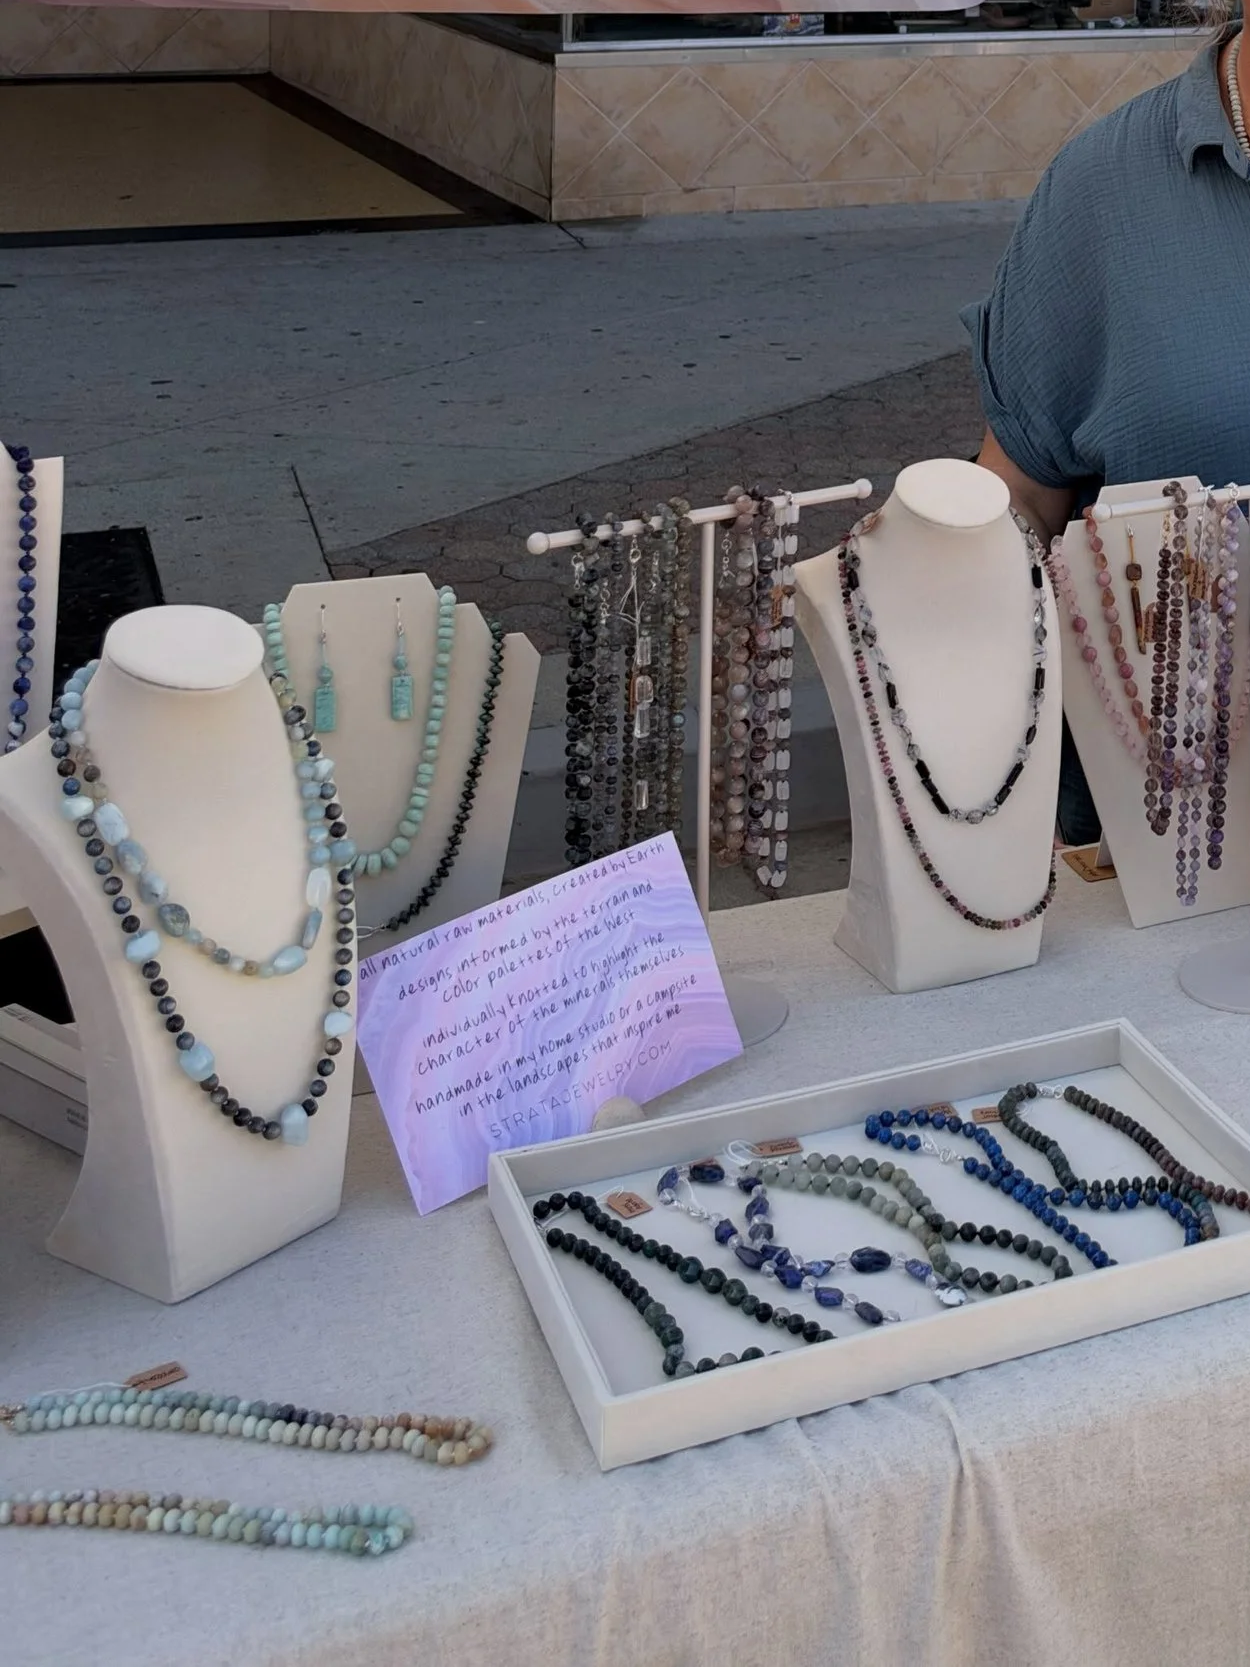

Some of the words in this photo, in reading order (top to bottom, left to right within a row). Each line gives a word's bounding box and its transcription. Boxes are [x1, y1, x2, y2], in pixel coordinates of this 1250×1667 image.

[360, 959, 377, 980] all
[381, 931, 440, 970] natural
[443, 922, 473, 942] raw
[477, 888, 550, 929] materials,
[552, 866, 607, 896] created
[610, 861, 626, 875] by
[626, 841, 665, 865] Earth
[398, 966, 452, 1001] designs
[457, 933, 528, 973] informed
[531, 928, 552, 941] by
[553, 911, 578, 930] the
[582, 890, 630, 918] terrain
[632, 878, 653, 897] and
[442, 975, 481, 1003] color
[487, 946, 552, 987] palettes
[555, 934, 573, 953] of
[578, 925, 601, 942] the
[603, 909, 636, 932] West
[415, 1070, 493, 1114] handmade
[498, 1060, 512, 1076] in
[515, 1051, 537, 1068] my
[538, 1032, 574, 1057] home
[578, 1011, 616, 1040] studio
[619, 1004, 632, 1020] or
[636, 999, 644, 1011] a
[646, 974, 697, 1004] campsite
[418, 1027, 501, 1076] character
[508, 1013, 526, 1034] of
[532, 1002, 559, 1022] the
[563, 976, 616, 1010] minerals
[618, 945, 685, 982] themselves
[422, 1001, 507, 1048] individually
[573, 965, 588, 979] to
[590, 941, 639, 976] highlight
[643, 932, 665, 948] the
[459, 1101, 474, 1118] in
[477, 1087, 505, 1109] the
[507, 1048, 589, 1094] landscapes
[591, 1032, 619, 1054] that
[623, 1013, 663, 1040] inspire
[665, 1002, 682, 1021] me
[489, 1040, 672, 1139] STRATAJEWELRY.COM
